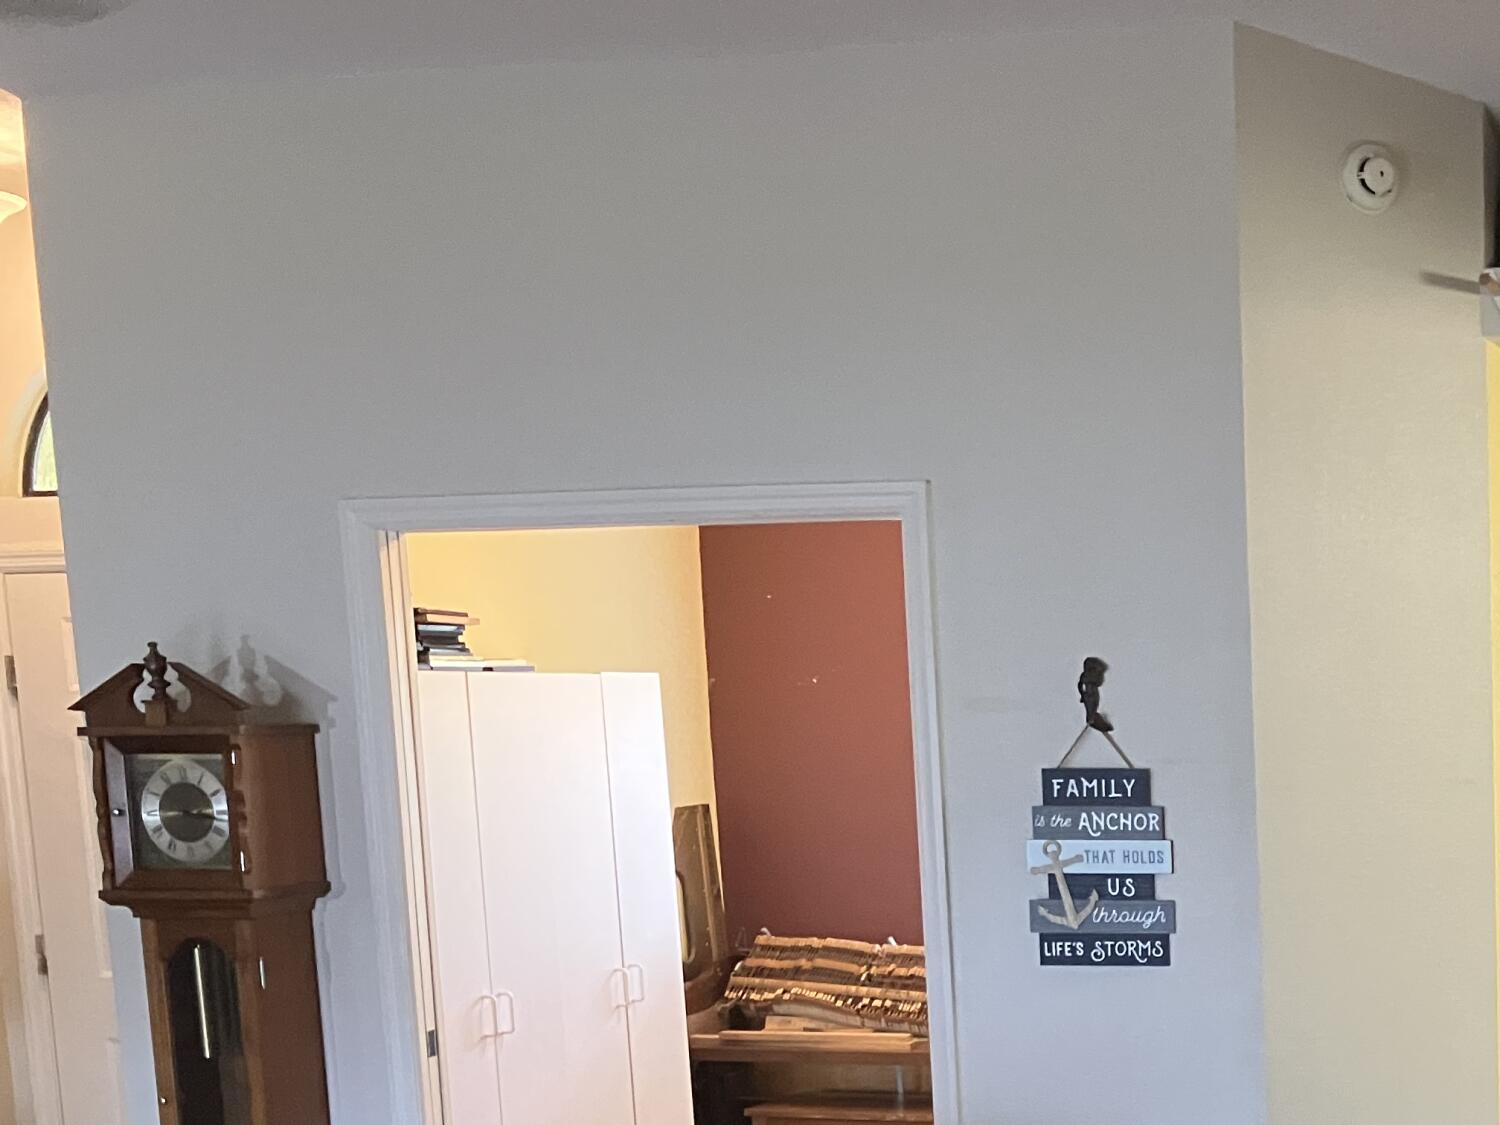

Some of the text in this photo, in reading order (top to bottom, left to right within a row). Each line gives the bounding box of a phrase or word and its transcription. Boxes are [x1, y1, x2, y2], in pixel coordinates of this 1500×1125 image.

[1051, 777, 1136, 798] FAMILY
[1034, 811, 1160, 837] is the ANCHOR
[1083, 849, 1165, 864] THAT HOLDS
[1107, 877, 1136, 897] US
[1092, 906, 1166, 929] through
[1044, 939, 1164, 963] LIFE'S STORMS
